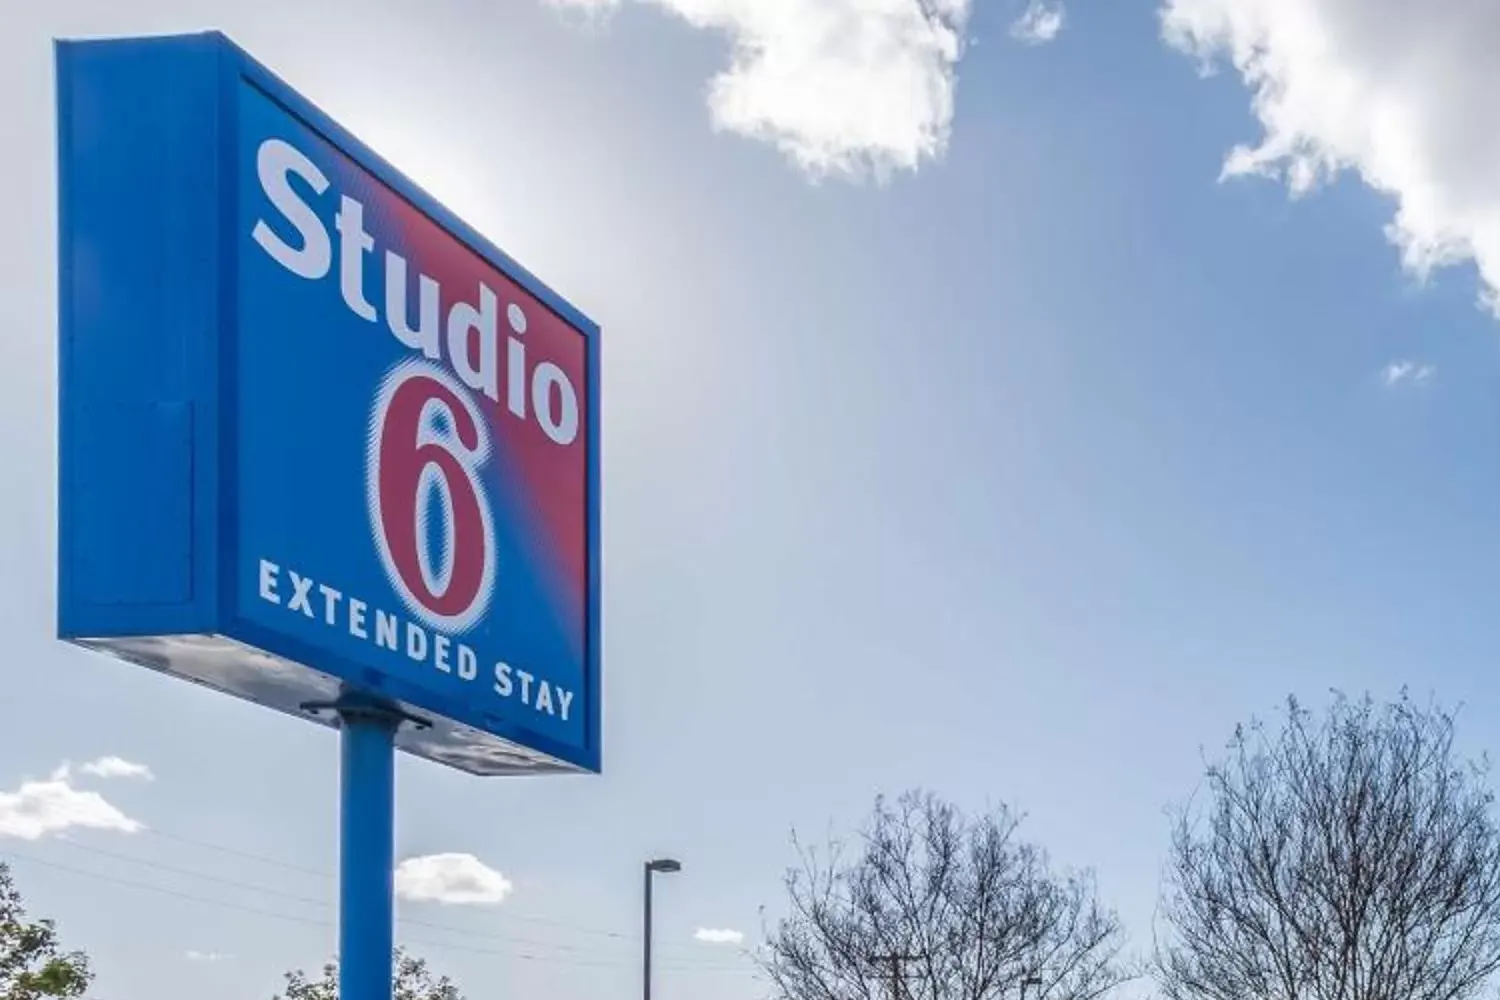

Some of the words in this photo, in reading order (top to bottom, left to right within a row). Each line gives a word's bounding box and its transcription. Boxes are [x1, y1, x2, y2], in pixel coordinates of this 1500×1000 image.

[252, 138, 579, 445] Studio
[370, 358, 497, 634] 6
[259, 559, 478, 681] EXTENDED
[493, 662, 574, 721] STAY
